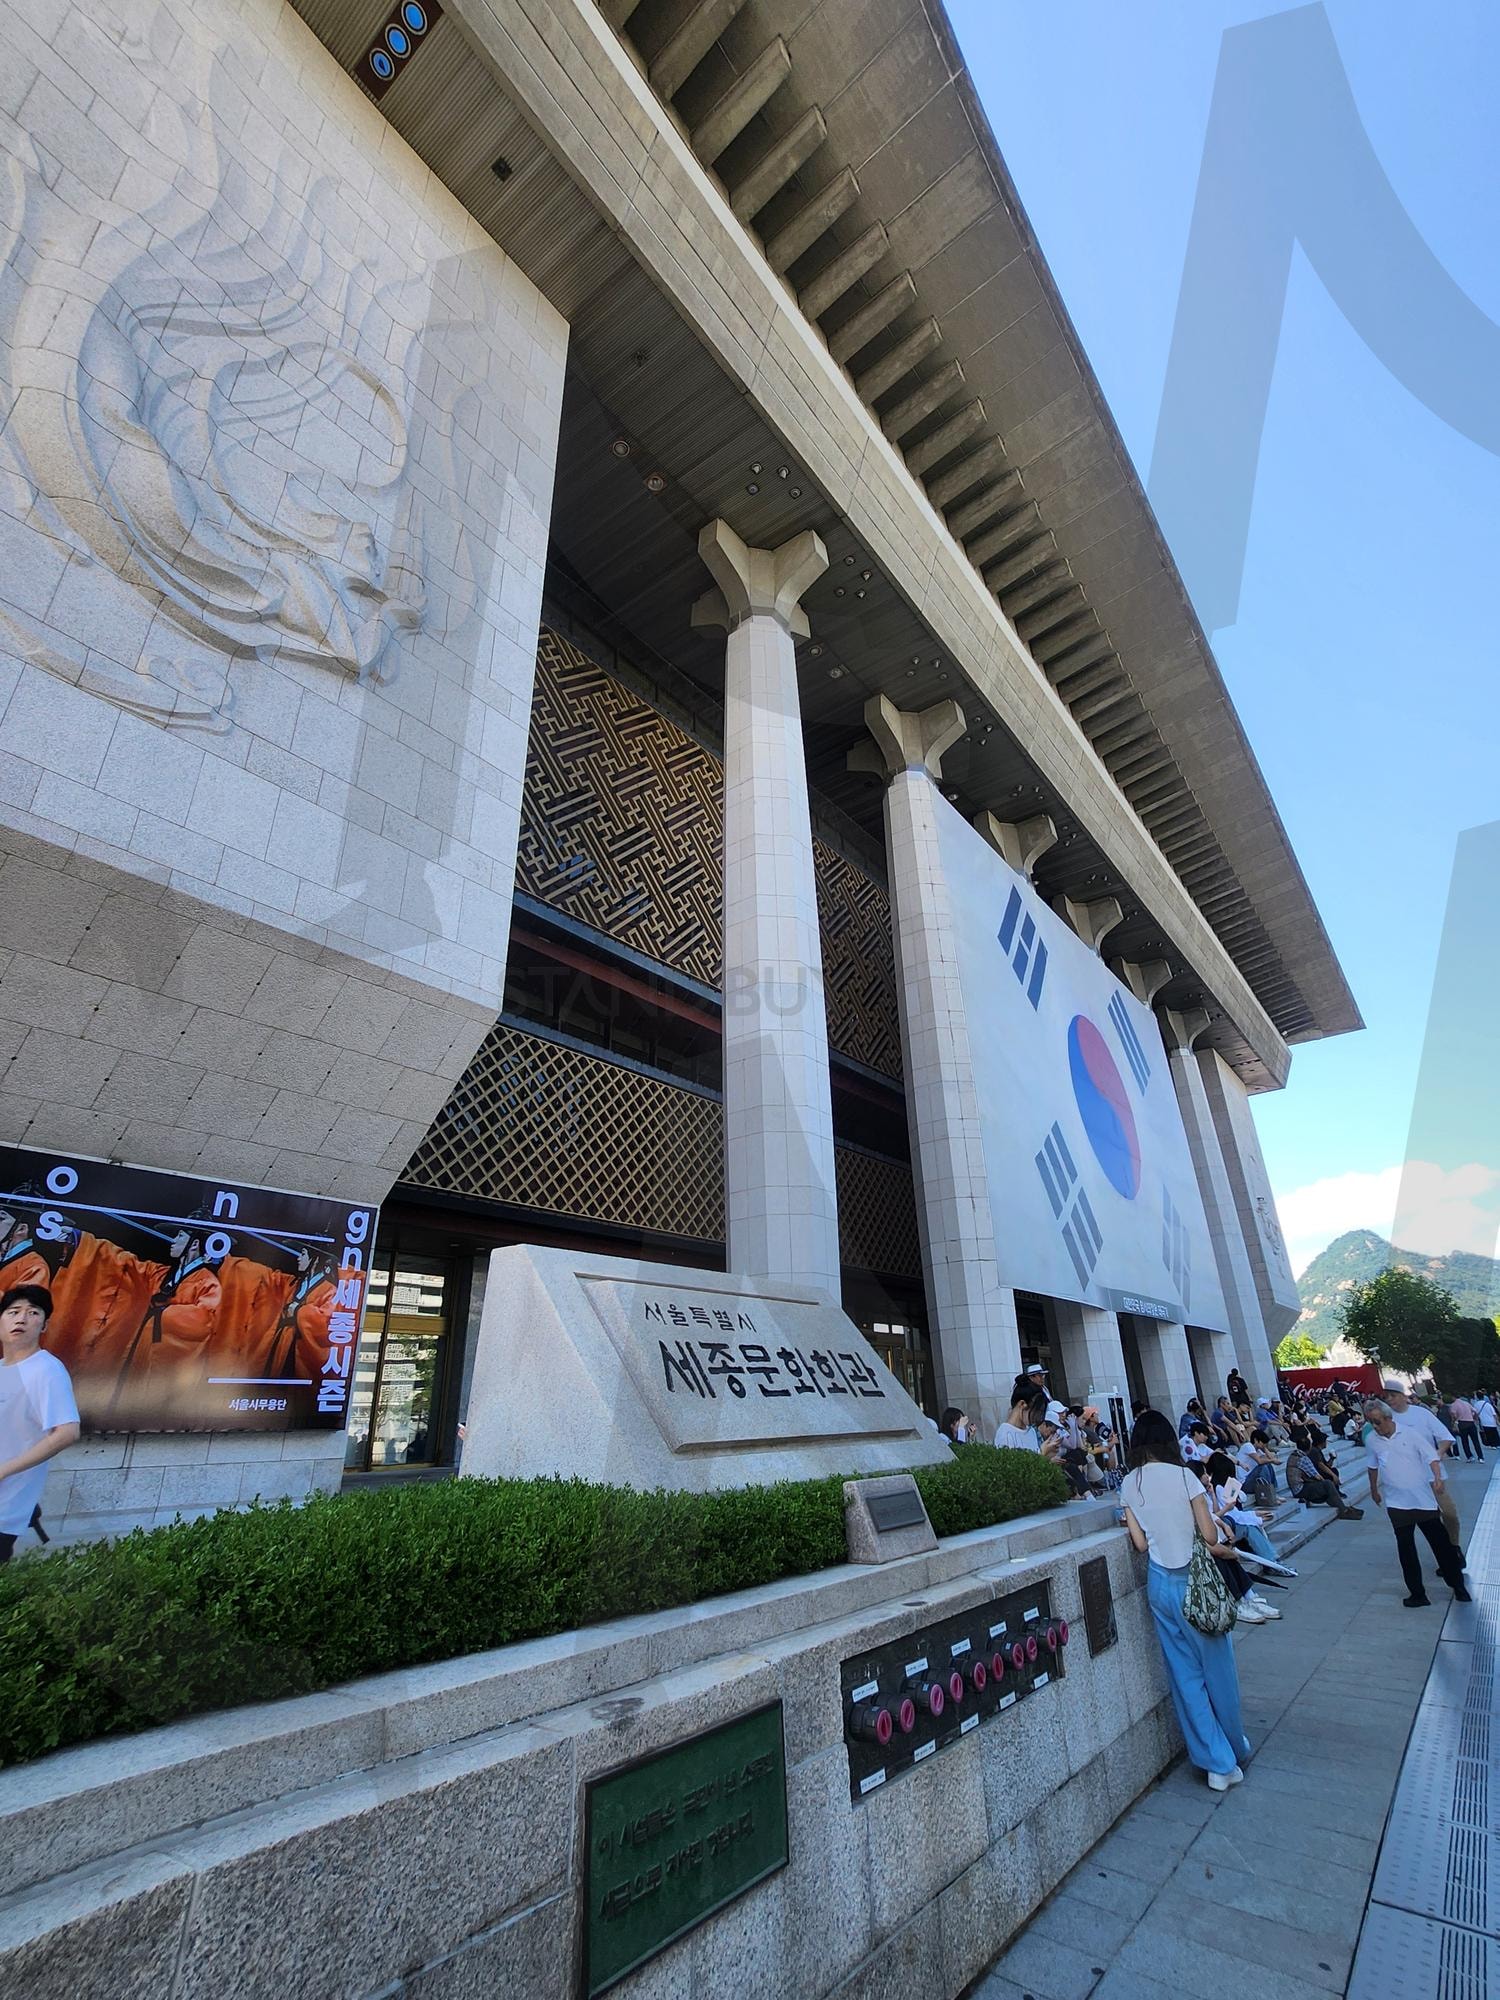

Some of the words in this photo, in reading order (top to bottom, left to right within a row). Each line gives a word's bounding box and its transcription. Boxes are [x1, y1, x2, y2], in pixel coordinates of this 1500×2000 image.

[644, 1301, 757, 1334] 서울특별시
[658, 1339, 886, 1399] 세종문화회관
[228, 1398, 288, 1412] 서울시무용단
